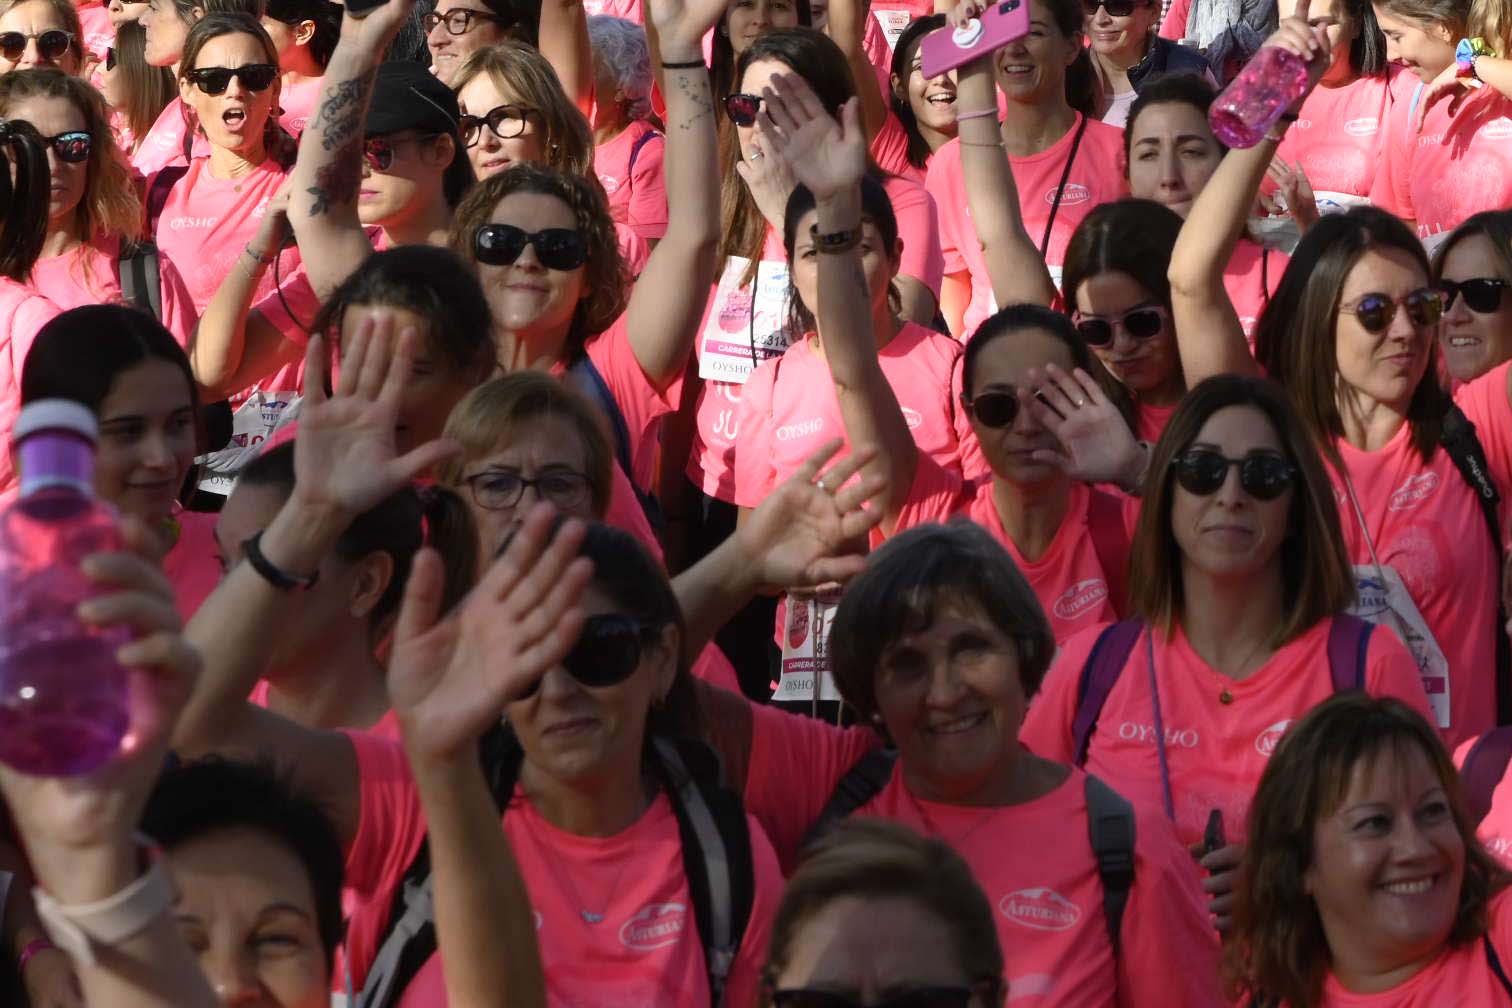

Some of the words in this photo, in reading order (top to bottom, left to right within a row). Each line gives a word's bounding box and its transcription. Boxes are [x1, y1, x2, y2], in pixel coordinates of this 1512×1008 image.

[776, 416, 824, 441] OYSHO
[1119, 722, 1199, 748] OYHO
[1007, 899, 1077, 923] ASTURIANA
